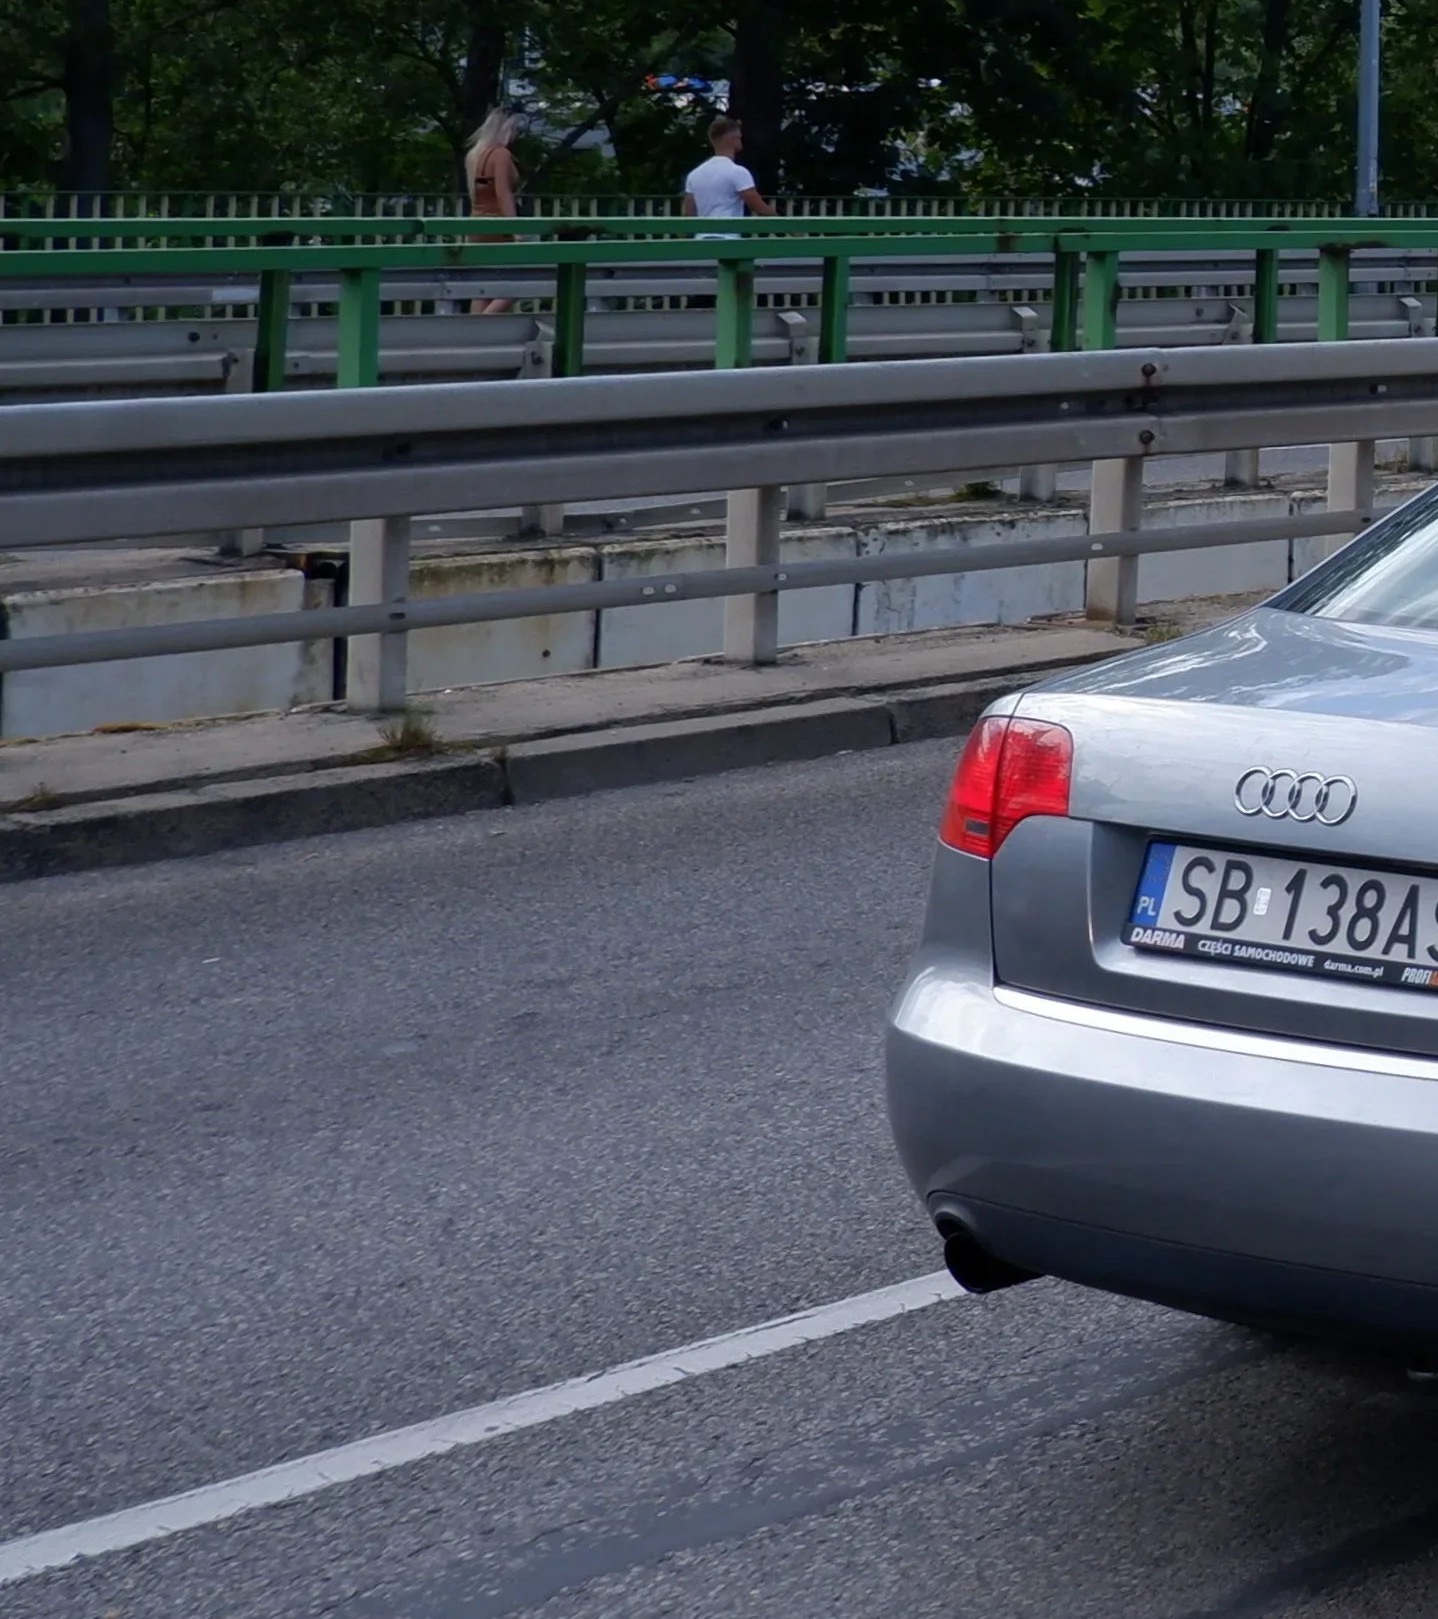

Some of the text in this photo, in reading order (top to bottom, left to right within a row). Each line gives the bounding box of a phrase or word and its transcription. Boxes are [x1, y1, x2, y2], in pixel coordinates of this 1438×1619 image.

[1136, 895, 1157, 917] PL
[1172, 855, 1254, 933] SB
[1129, 927, 1187, 950] DARMA
[1198, 939, 1232, 956] CZĘŚCI
[1233, 944, 1315, 968] SAMOCHODOWE
[1324, 959, 1385, 979] darma.com.pl
